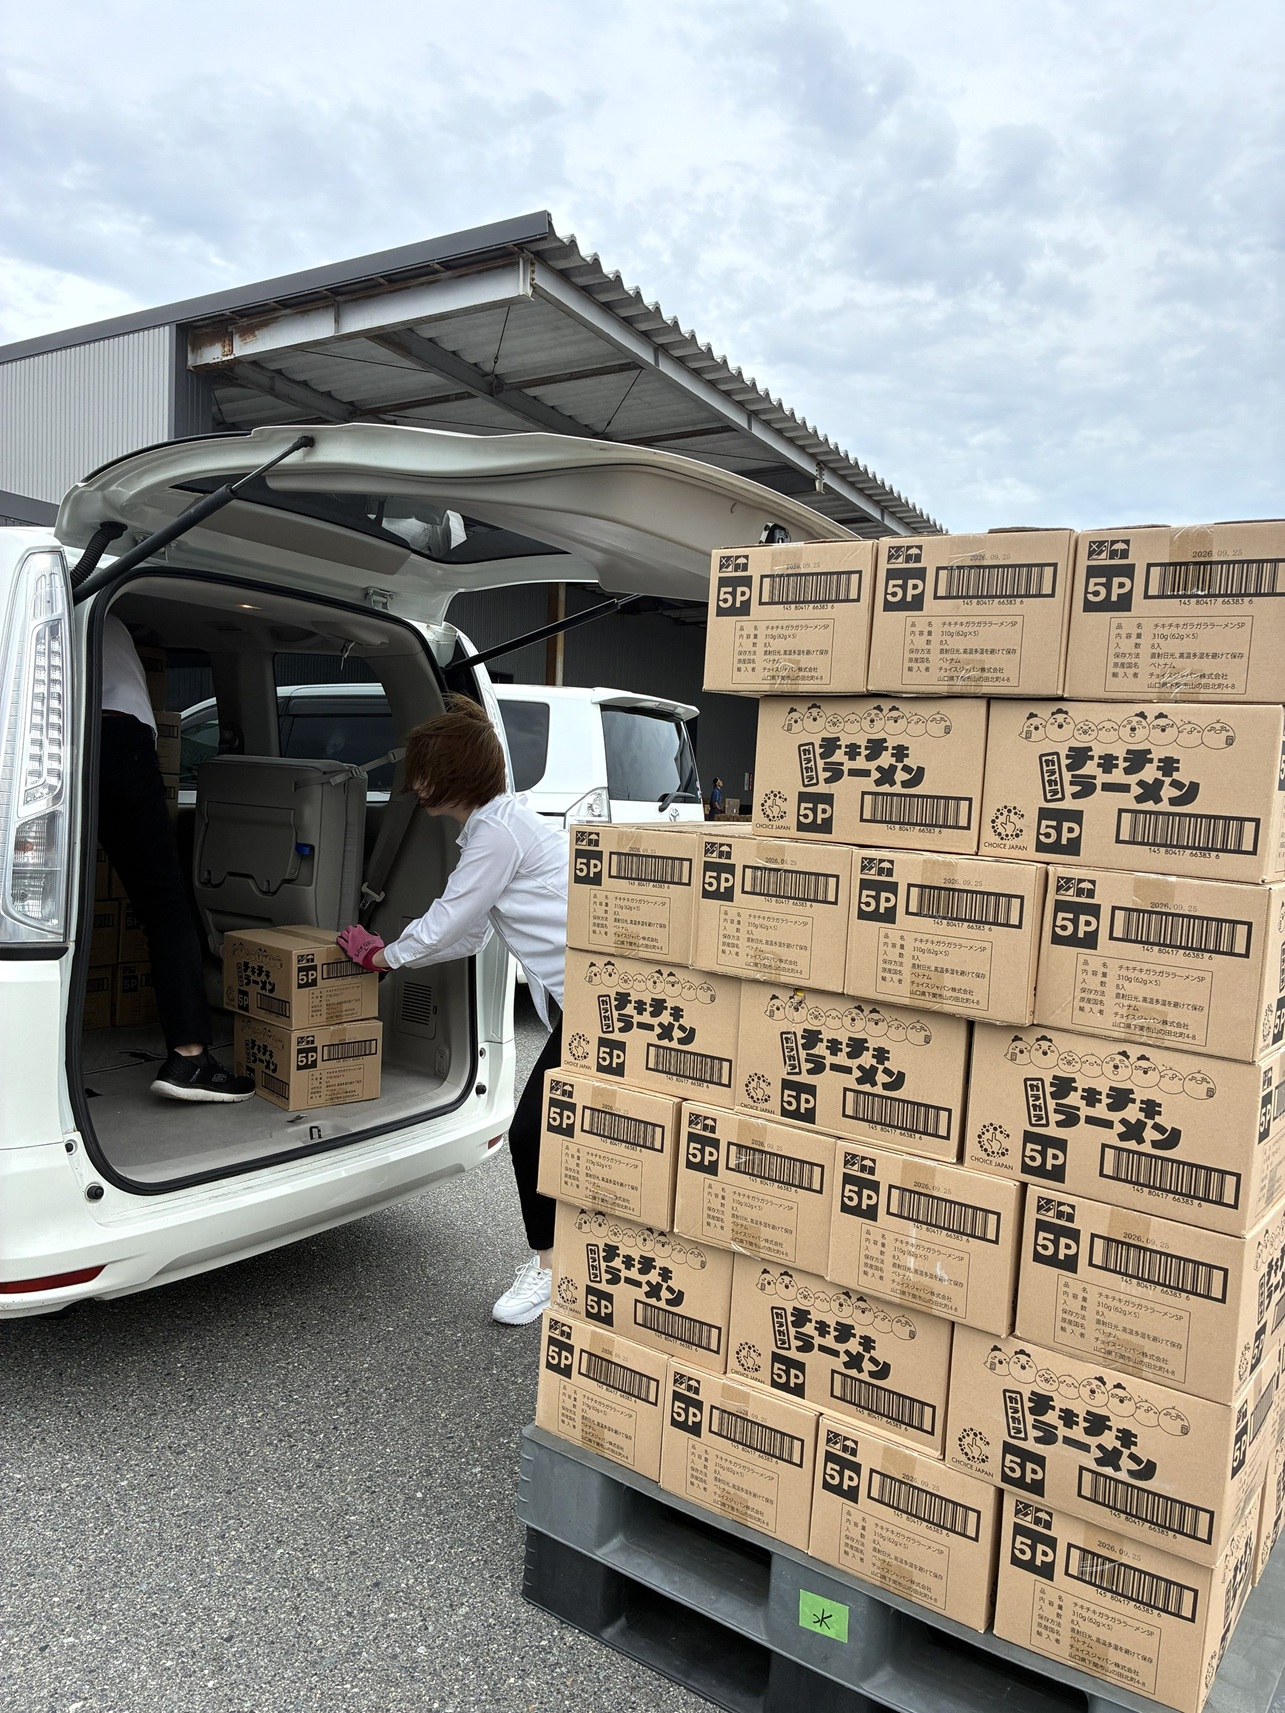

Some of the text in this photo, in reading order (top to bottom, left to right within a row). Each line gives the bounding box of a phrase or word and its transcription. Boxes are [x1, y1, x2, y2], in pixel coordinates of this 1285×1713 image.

[1191, 548, 1243, 558] 2026.09.25
[718, 586, 751, 608] 5P
[886, 579, 924, 602] 5P
[1086, 577, 1132, 602] 5P
[1178, 599, 1192, 607] 145
[1194, 598, 1218, 606] 80417
[1221, 598, 1245, 606] 66383
[1150, 642, 1163, 650] 8入
[1149, 661, 1177, 670] ベトナム
[818, 735, 910, 764] チキチキ
[1064, 745, 1181, 778] チキチキ
[801, 746, 816, 784] ガラガラ
[822, 760, 926, 789] ラーメン
[1043, 756, 1060, 799] ガラガラ
[1068, 773, 1201, 808] ラーメン
[799, 802, 832, 824] 5P
[754, 822, 774, 830] CHOICE
[1038, 819, 1081, 845] 5P
[983, 841, 1028, 852] CHOICE JAPAN
[1148, 846, 1162, 855] 145
[1163, 847, 1187, 857] 80417
[1188, 849, 1213, 859] 66383
[575, 858, 602, 877] 5P
[704, 871, 734, 893] 5P
[942, 876, 983, 888] 2026.09.25
[859, 889, 896, 913] 5P
[1149, 900, 1198, 914] 2026.09.25
[1054, 911, 1098, 938] 5P
[1141, 945, 1154, 953] 145
[1157, 947, 1180, 957] 80417
[1182, 950, 1205, 960] 66383
[244, 973, 276, 994] ラーメン
[298, 970, 317, 985] 5P
[1115, 983, 1127, 992] 8入
[613, 990, 684, 1023] チキチキ
[1113, 1002, 1140, 1013] ベトナム
[616, 1012, 697, 1046] ラーメン
[297, 1052, 317, 1066] 5P
[598, 1046, 625, 1068] 5P
[800, 1027, 891, 1066] チキチキ
[804, 1051, 906, 1092] ラーメン
[739, 1102, 775, 1115] CHOICE JAPAN
[782, 1089, 815, 1113] 5P
[1028, 1082, 1045, 1124] ガラガラ
[1049, 1073, 1163, 1121] チキチキ
[549, 1106, 575, 1128] 5P
[1053, 1101, 1183, 1151] ラーメン
[1259, 1103, 1272, 1133] 5P
[688, 1142, 718, 1166] 5P
[969, 1154, 1014, 1171] CHOICE JAPAN
[1024, 1142, 1065, 1171] 5P
[843, 1183, 878, 1210] 5P
[1131, 1185, 1145, 1194] 145
[1146, 1188, 1169, 1200] 80417
[1171, 1194, 1195, 1207] 66383
[1035, 1231, 1078, 1260] 5P
[1122, 1230, 1170, 1250] 2026.09.25
[602, 1241, 674, 1284] チキチキ
[604, 1263, 685, 1308] ラーメン
[586, 1294, 612, 1317] 5P
[1095, 1309, 1107, 1319] 8入
[774, 1310, 788, 1347] ガラガラ
[790, 1305, 877, 1354] チキチキ
[547, 1345, 573, 1369] 5P
[793, 1329, 892, 1381] ラーメン
[772, 1362, 804, 1388] 5P
[672, 1400, 702, 1426] 5P
[1007, 1394, 1023, 1437] ガラガラ
[1027, 1388, 1139, 1451] チキチキ
[1031, 1416, 1158, 1483] ラーメン
[1232, 1433, 1247, 1468] 5P
[824, 1461, 859, 1491] 5P
[951, 1456, 994, 1479] CHOICE JAPAN
[1003, 1453, 1043, 1484] 5P
[1109, 1510, 1122, 1519] 145
[1124, 1515, 1145, 1528] 80417
[1148, 1524, 1170, 1537] 66383
[1013, 1535, 1055, 1567] 5P
[1096, 1538, 1142, 1563] 2026.09.25
